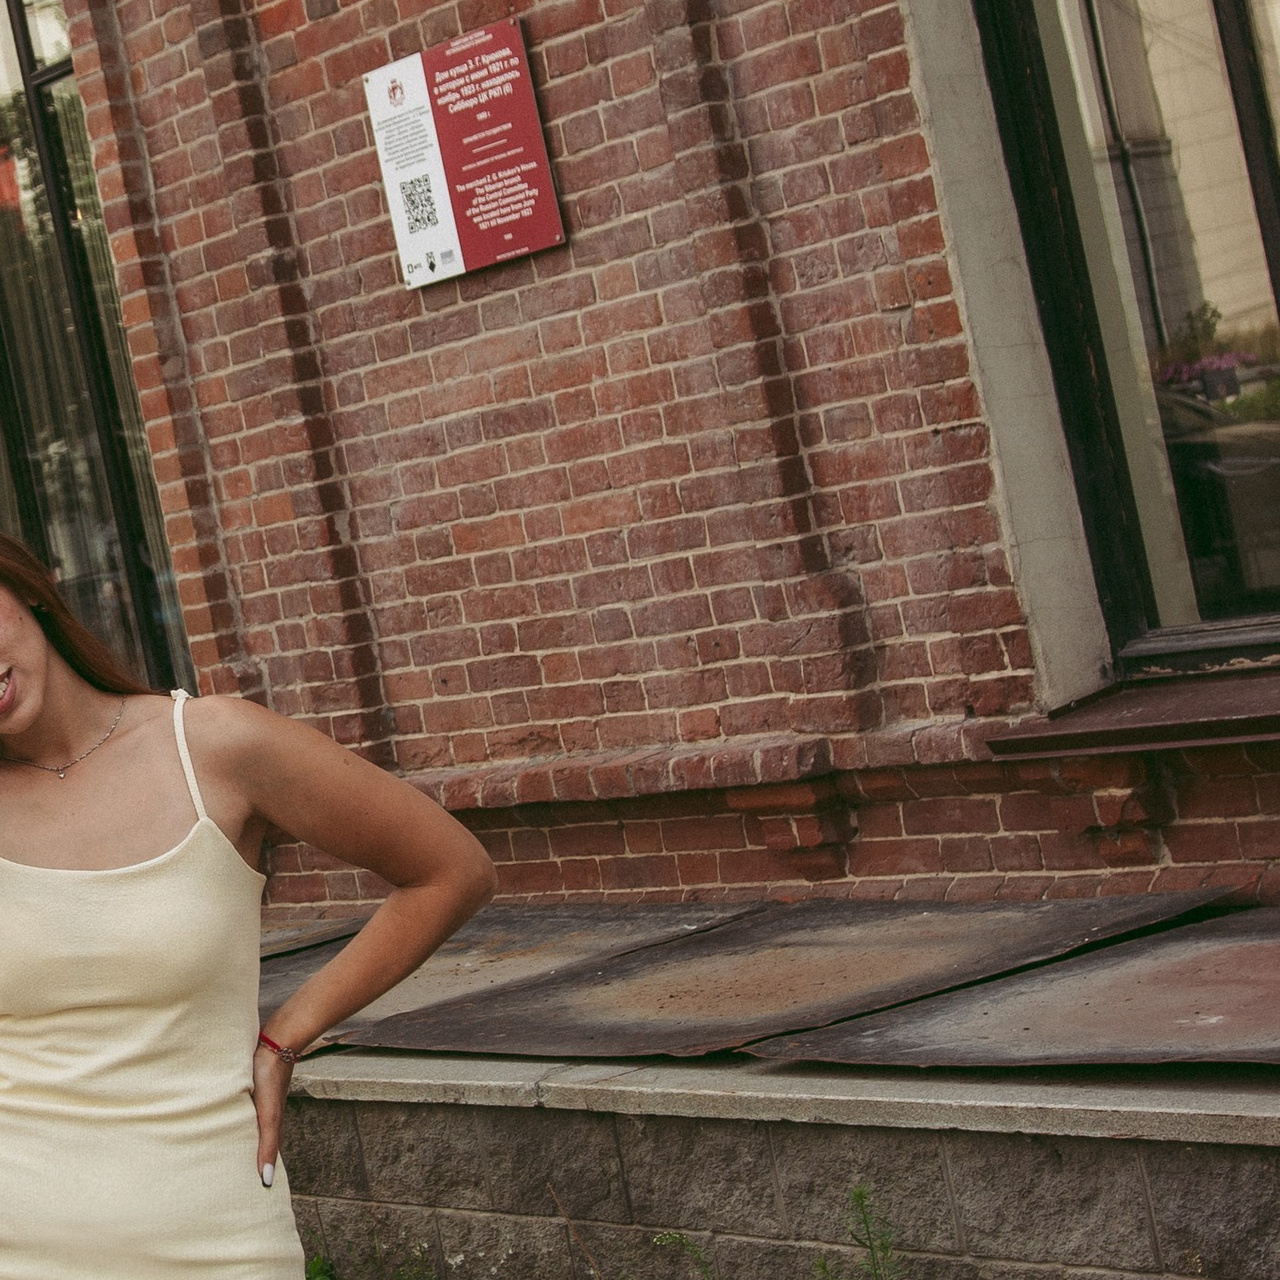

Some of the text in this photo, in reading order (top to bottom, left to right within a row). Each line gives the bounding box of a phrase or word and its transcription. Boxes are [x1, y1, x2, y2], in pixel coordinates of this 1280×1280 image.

[488, 61, 503, 74] 1921
[478, 91, 489, 103] ЦК
[472, 197, 478, 205] of
[466, 208, 472, 216] of
